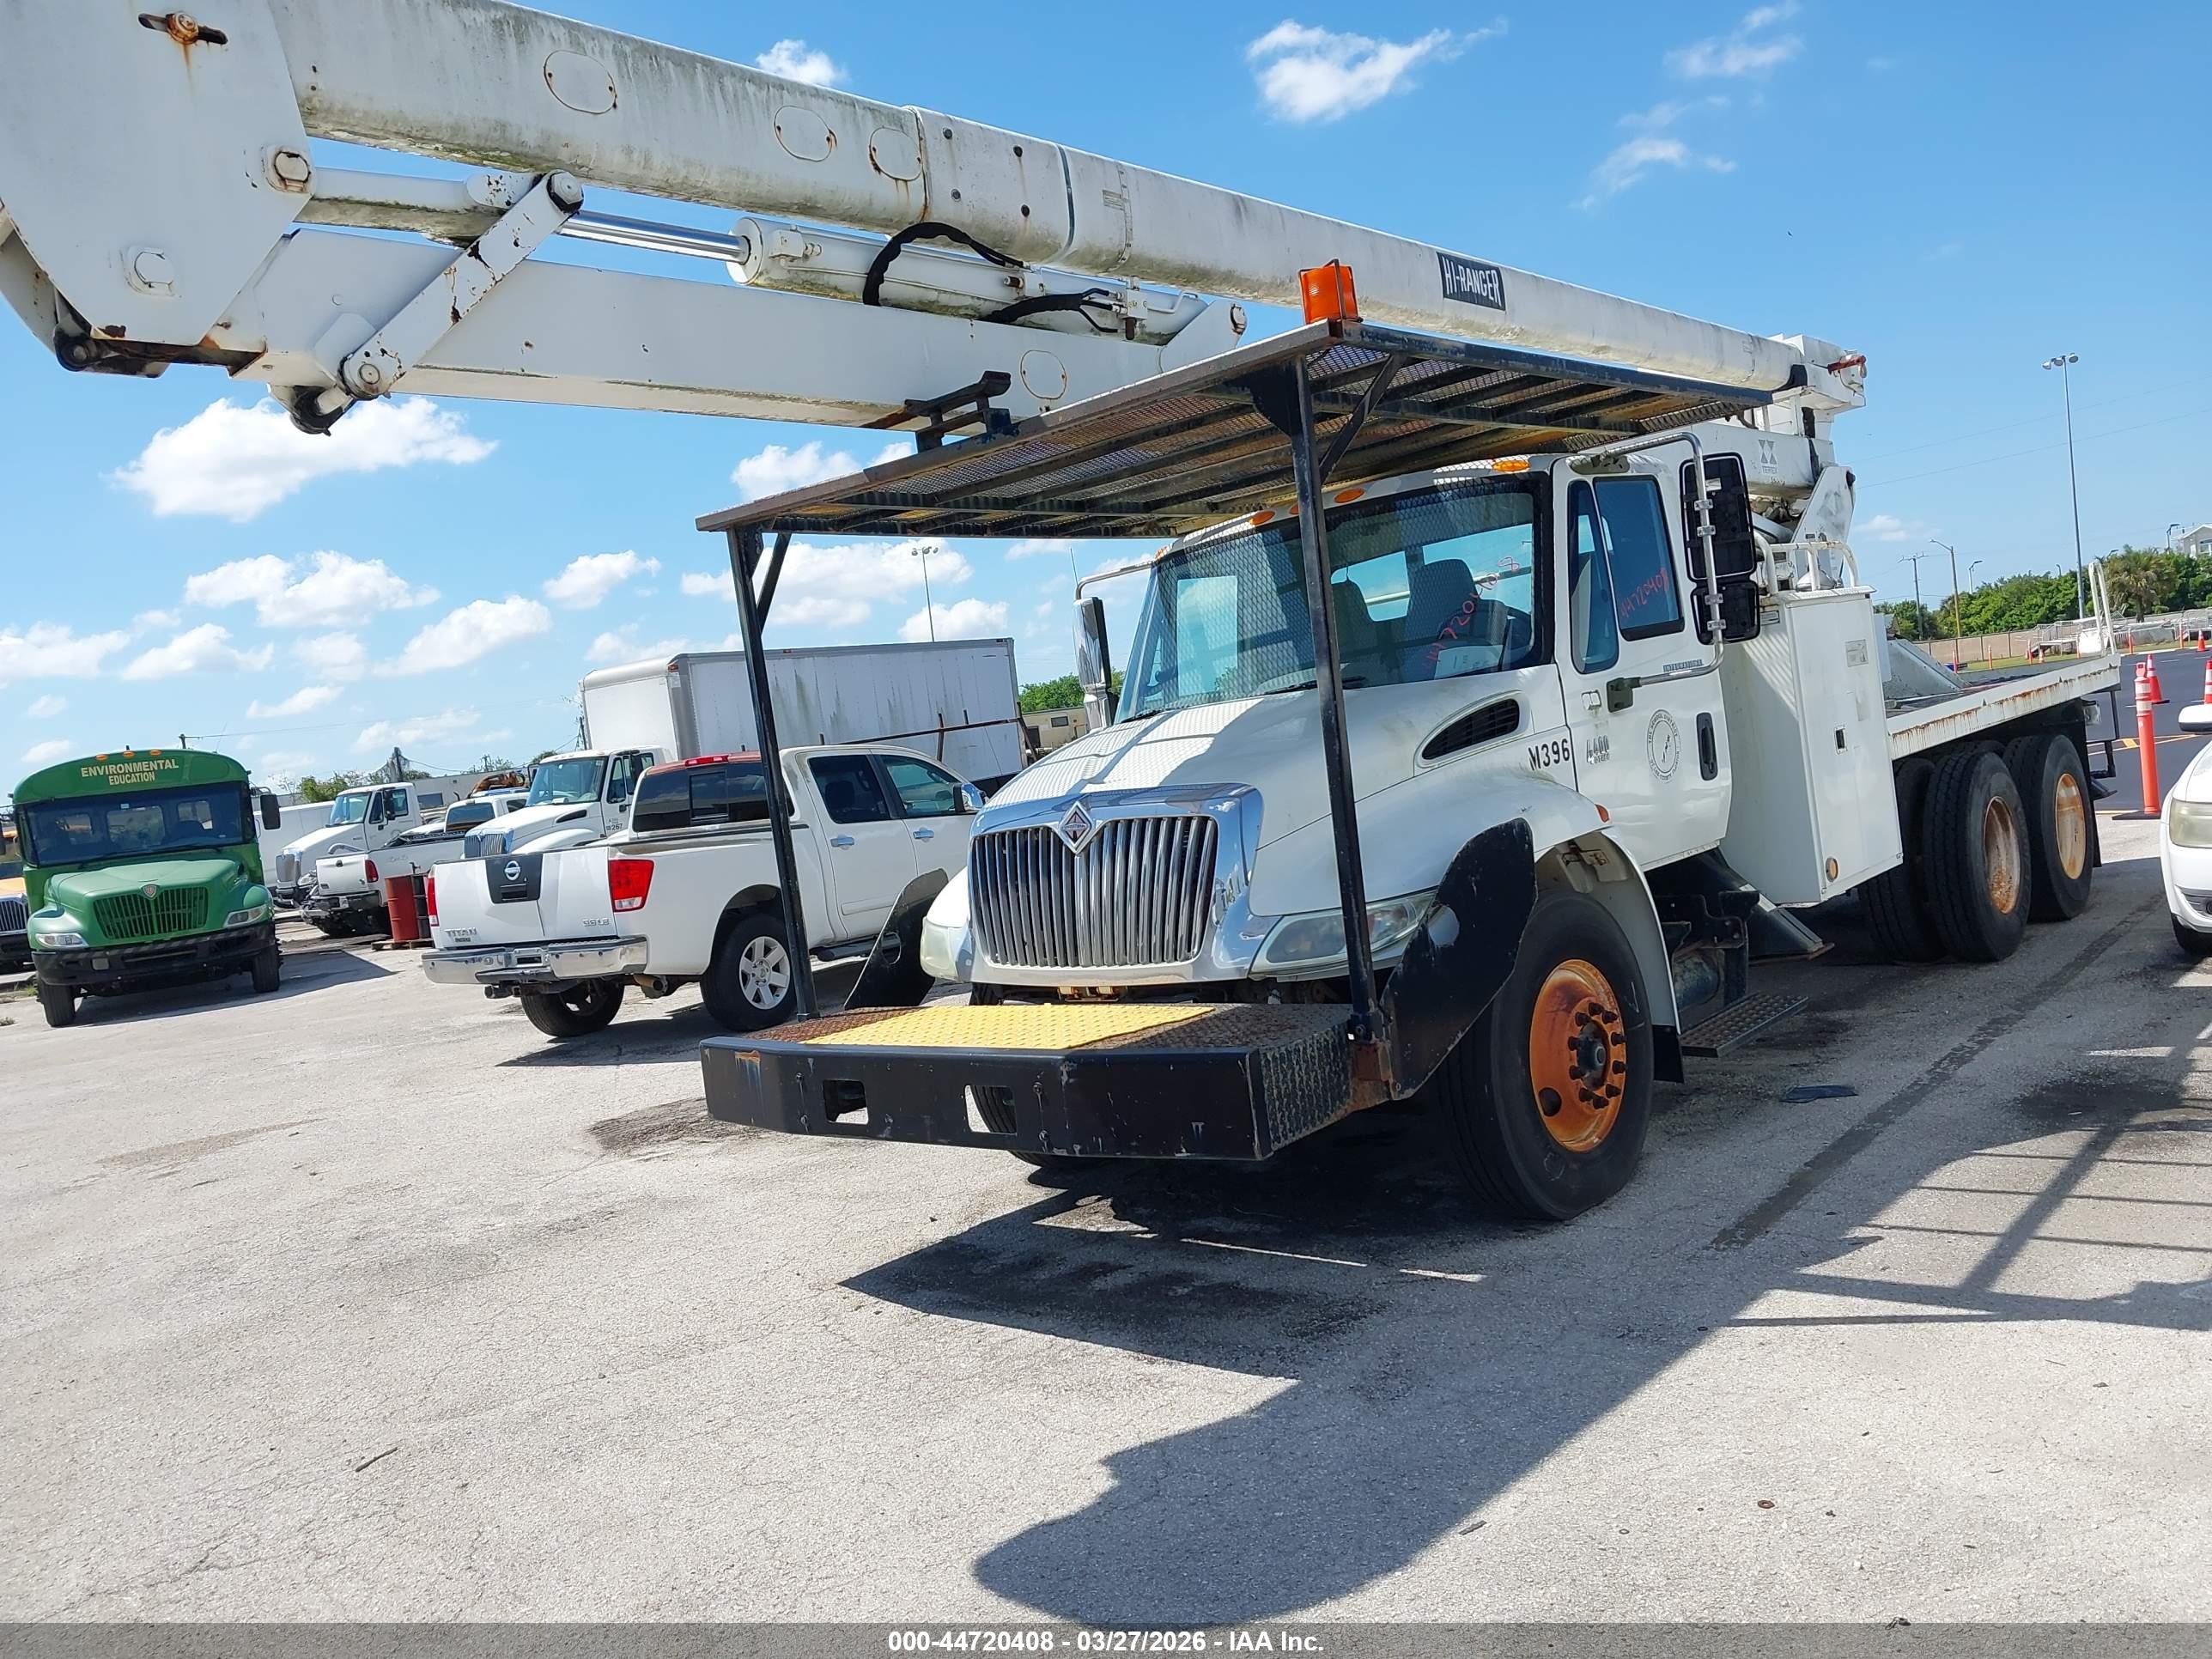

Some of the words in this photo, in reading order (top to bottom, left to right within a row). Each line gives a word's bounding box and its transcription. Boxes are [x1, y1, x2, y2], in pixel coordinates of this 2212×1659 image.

[1441, 255, 1502, 307] HI-RANGER
[1528, 738, 1571, 771] M396
[80, 758, 179, 778] ENVIRONMENTAL
[108, 771, 156, 786] EDUCATION
